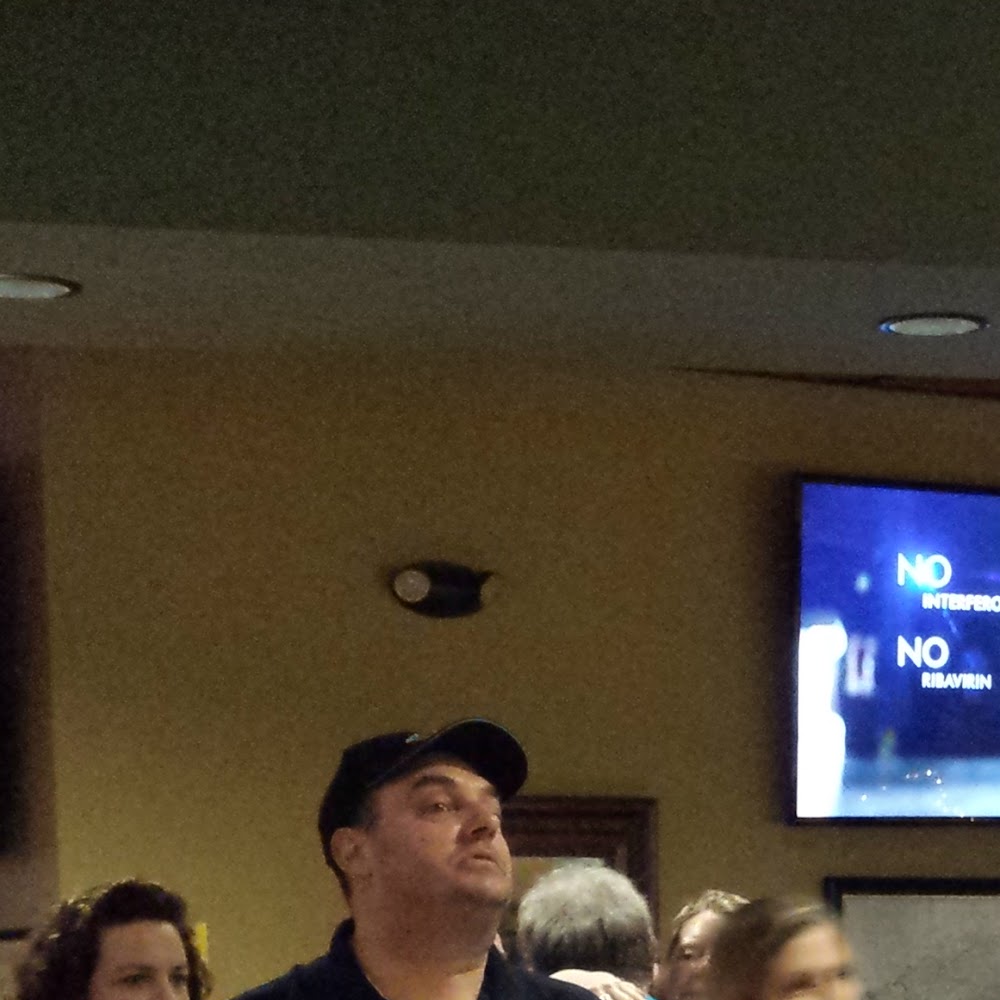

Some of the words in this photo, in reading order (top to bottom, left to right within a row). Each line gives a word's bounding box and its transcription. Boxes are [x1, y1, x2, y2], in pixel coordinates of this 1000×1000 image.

[897, 552, 952, 589] NO
[897, 635, 950, 669] NO
[921, 672, 992, 690] RIBAVIRIN
